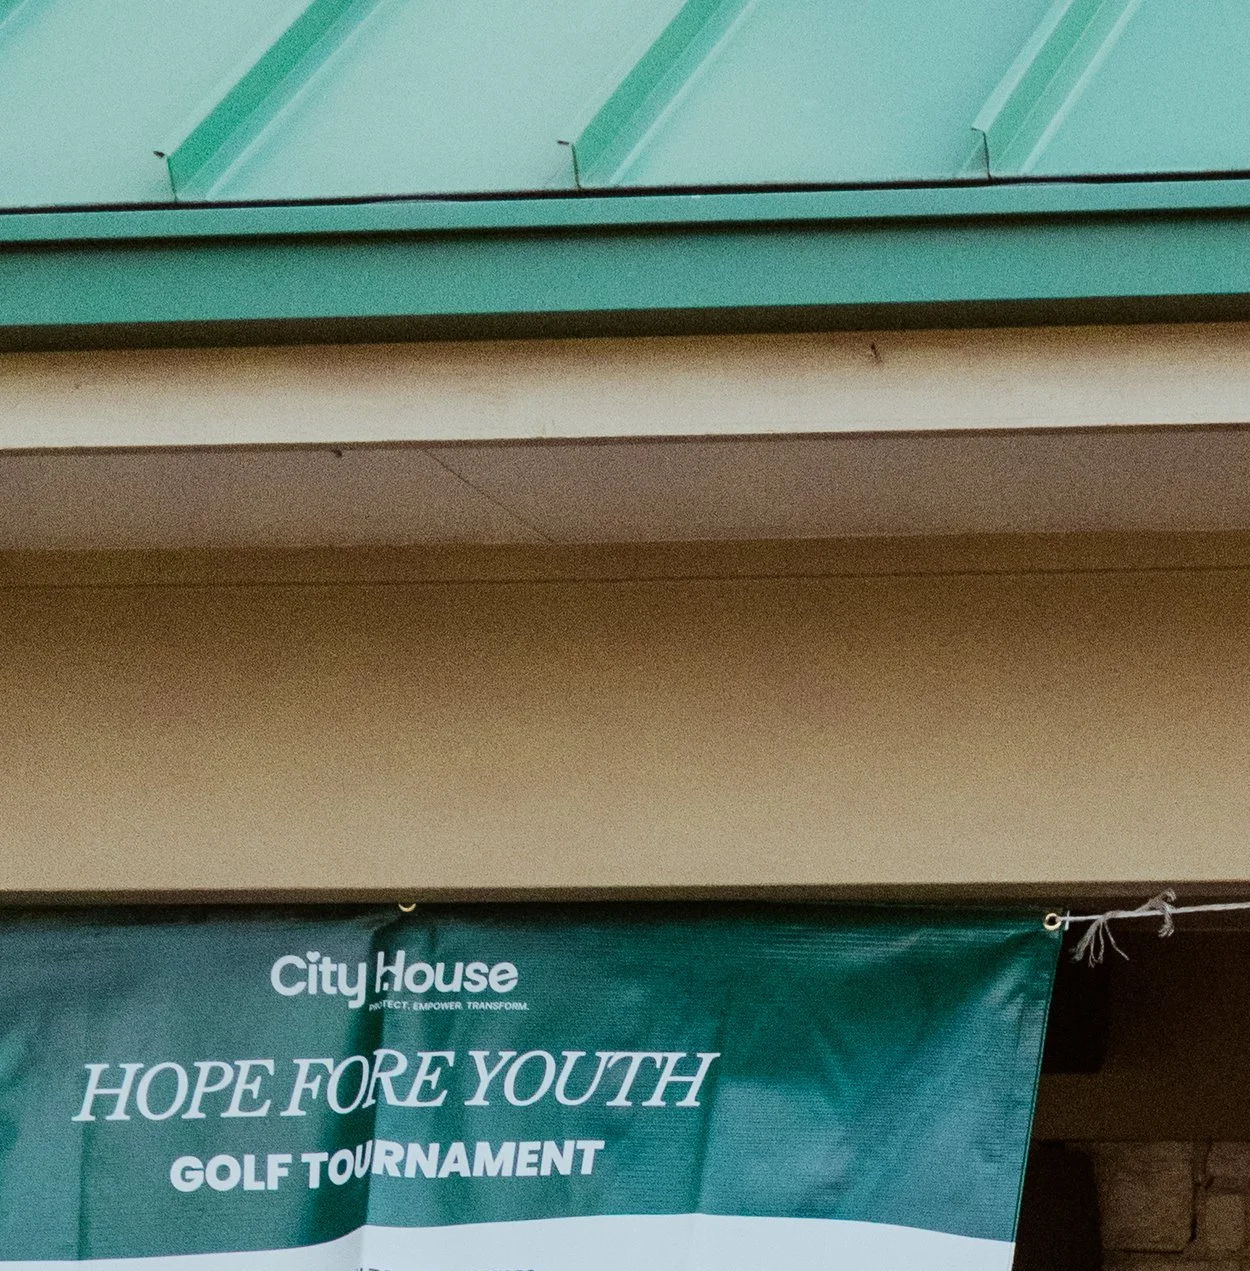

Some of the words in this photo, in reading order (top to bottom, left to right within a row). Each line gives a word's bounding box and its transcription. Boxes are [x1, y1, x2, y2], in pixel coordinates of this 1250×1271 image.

[270, 951, 367, 1008] City
[375, 950, 518, 994] House
[413, 1001, 463, 1011] EMPOWER.
[467, 1001, 529, 1011] TRANSFORM.
[71, 1060, 275, 1122] HOPE
[280, 1049, 455, 1117] FORE
[464, 1049, 721, 1108] YOUTH
[170, 1154, 292, 1192] GOLF
[301, 1138, 605, 1190] TOURNAMENT
